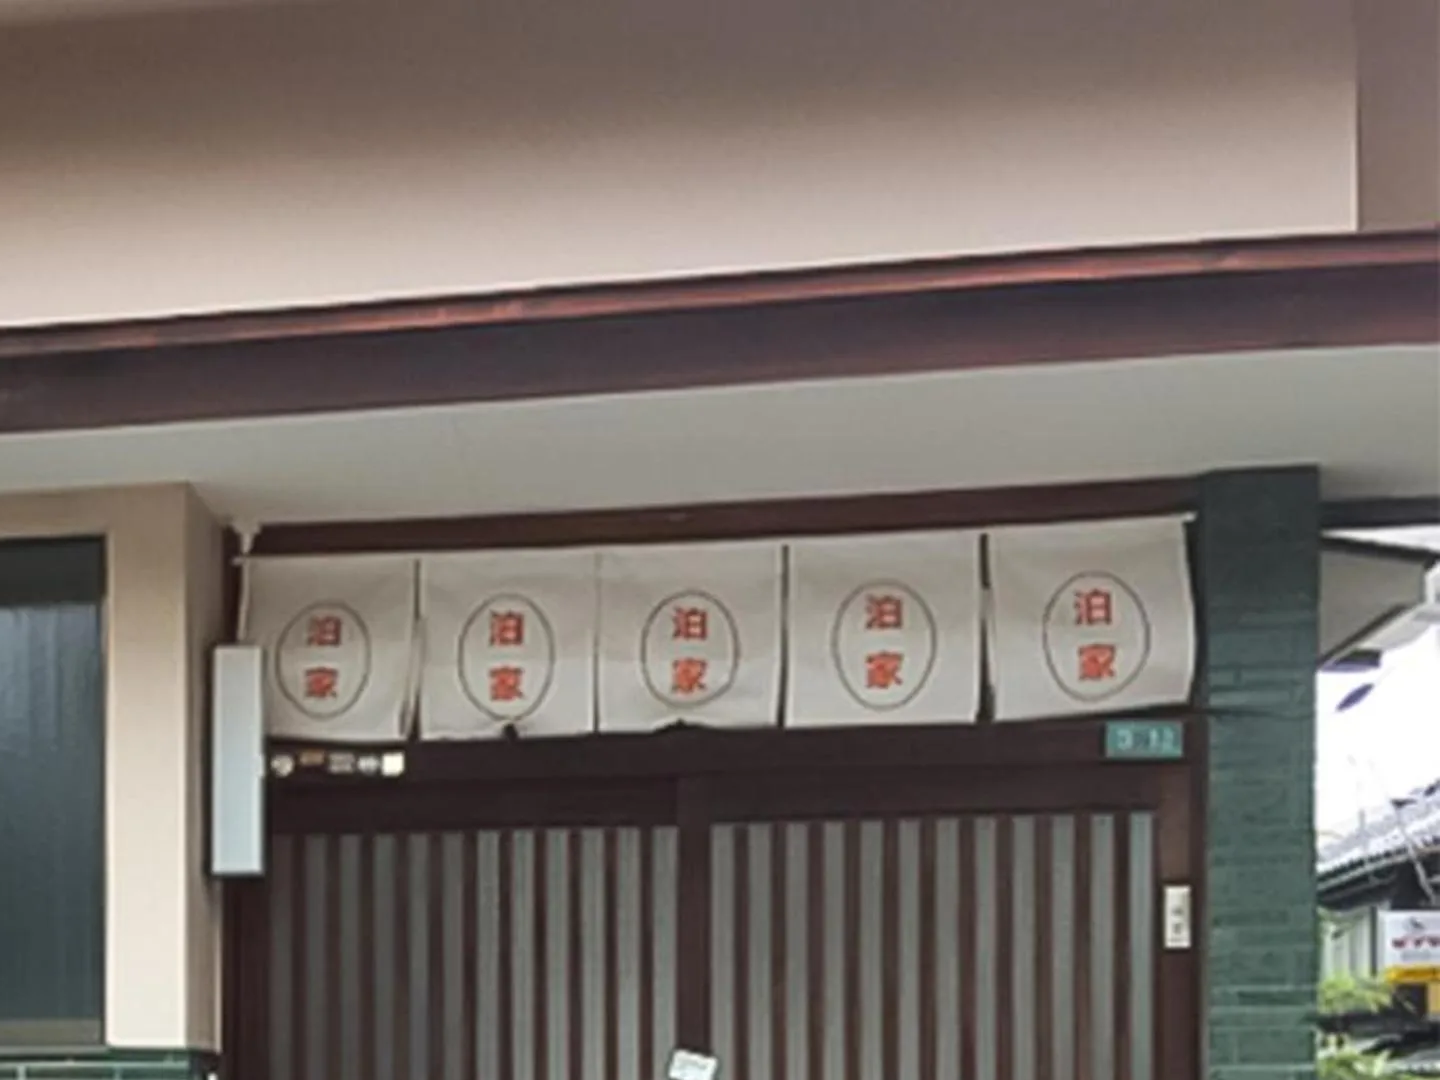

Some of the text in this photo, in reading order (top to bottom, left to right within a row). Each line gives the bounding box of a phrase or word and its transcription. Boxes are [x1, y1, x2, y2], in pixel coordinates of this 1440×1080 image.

[305, 615, 343, 698] 泊家
[488, 610, 525, 702] 泊家
[671, 605, 710, 698] 泊家
[864, 595, 903, 689] 泊家
[1074, 588, 1116, 680] 泊家
